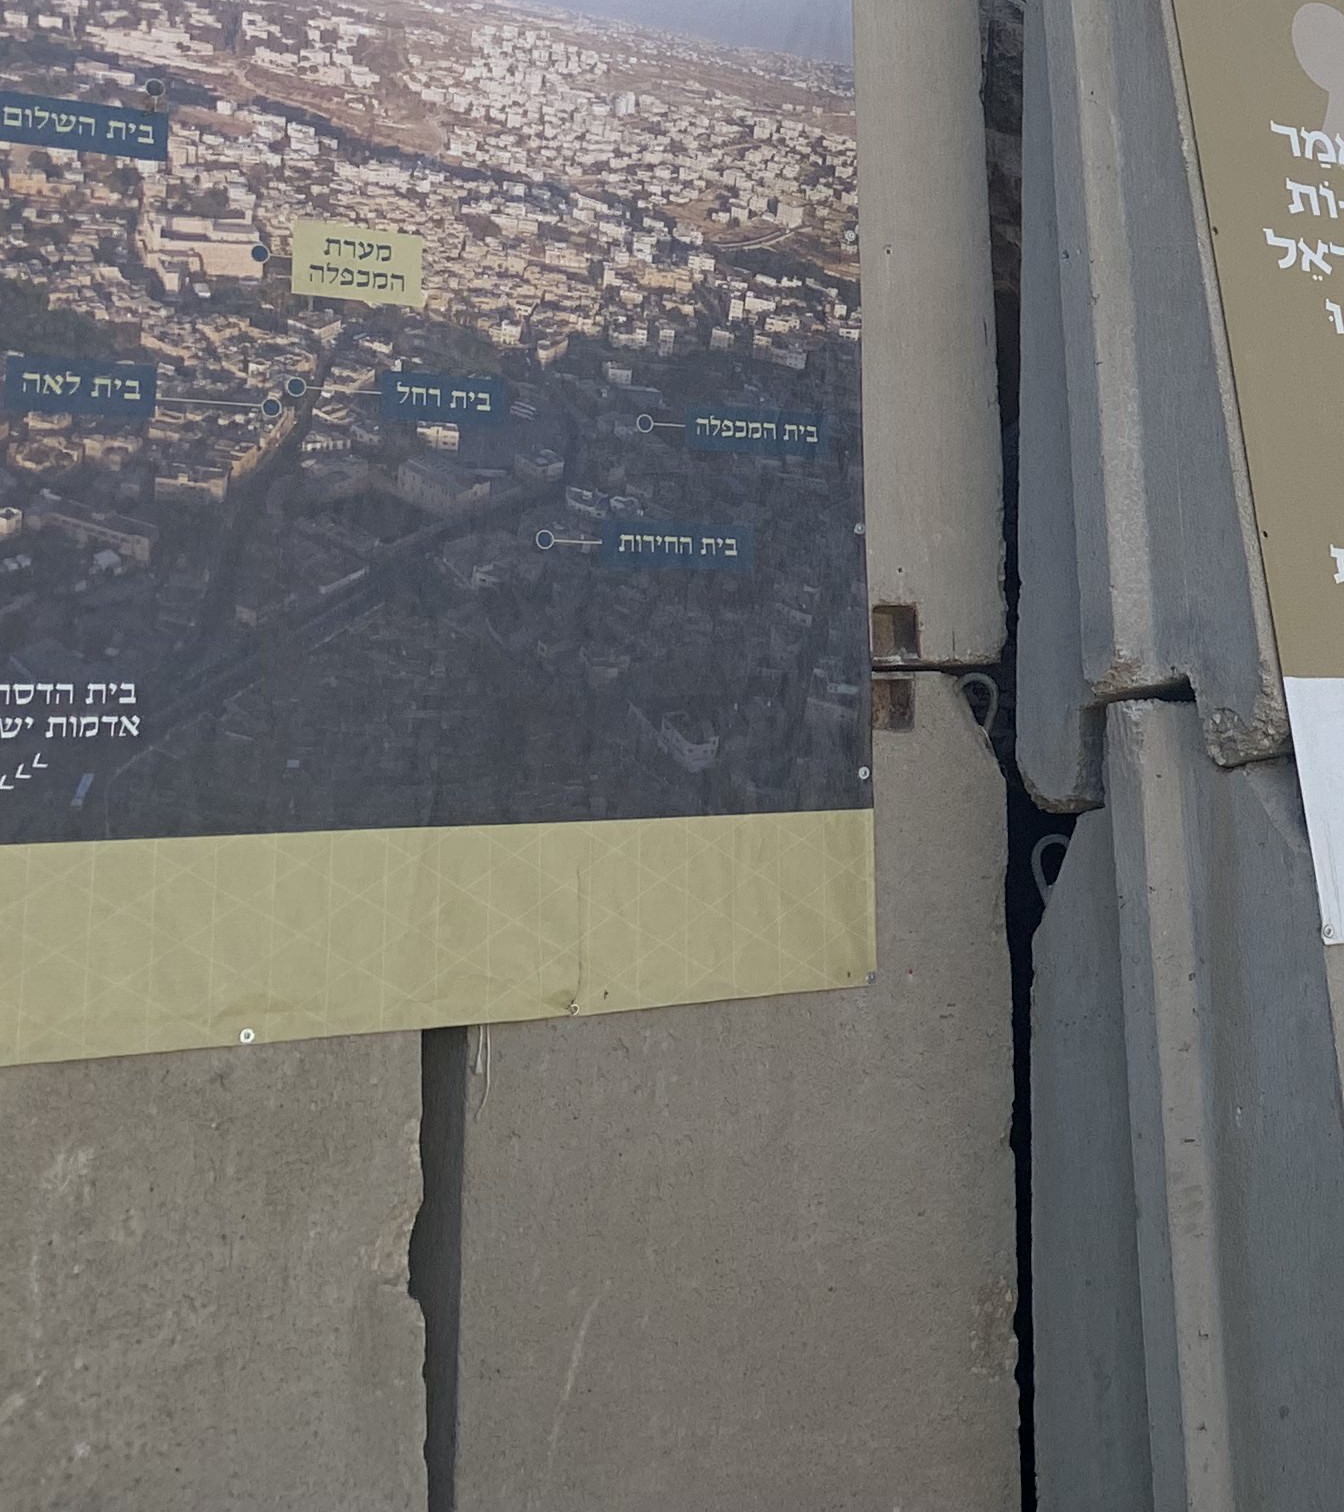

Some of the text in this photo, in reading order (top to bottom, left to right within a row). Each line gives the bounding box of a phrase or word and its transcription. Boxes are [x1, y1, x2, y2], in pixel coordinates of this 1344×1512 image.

[4, 106, 154, 144] בית השלום
[324, 237, 391, 262] מערת
[310, 262, 404, 292] המכפלה
[23, 371, 140, 399] בית לאה
[397, 382, 490, 411] בית רחל
[696, 416, 818, 442] בית המכפלה
[619, 534, 737, 556] בית החירות
[85, 683, 136, 704] בית
[45, 715, 140, 738] אדמות
